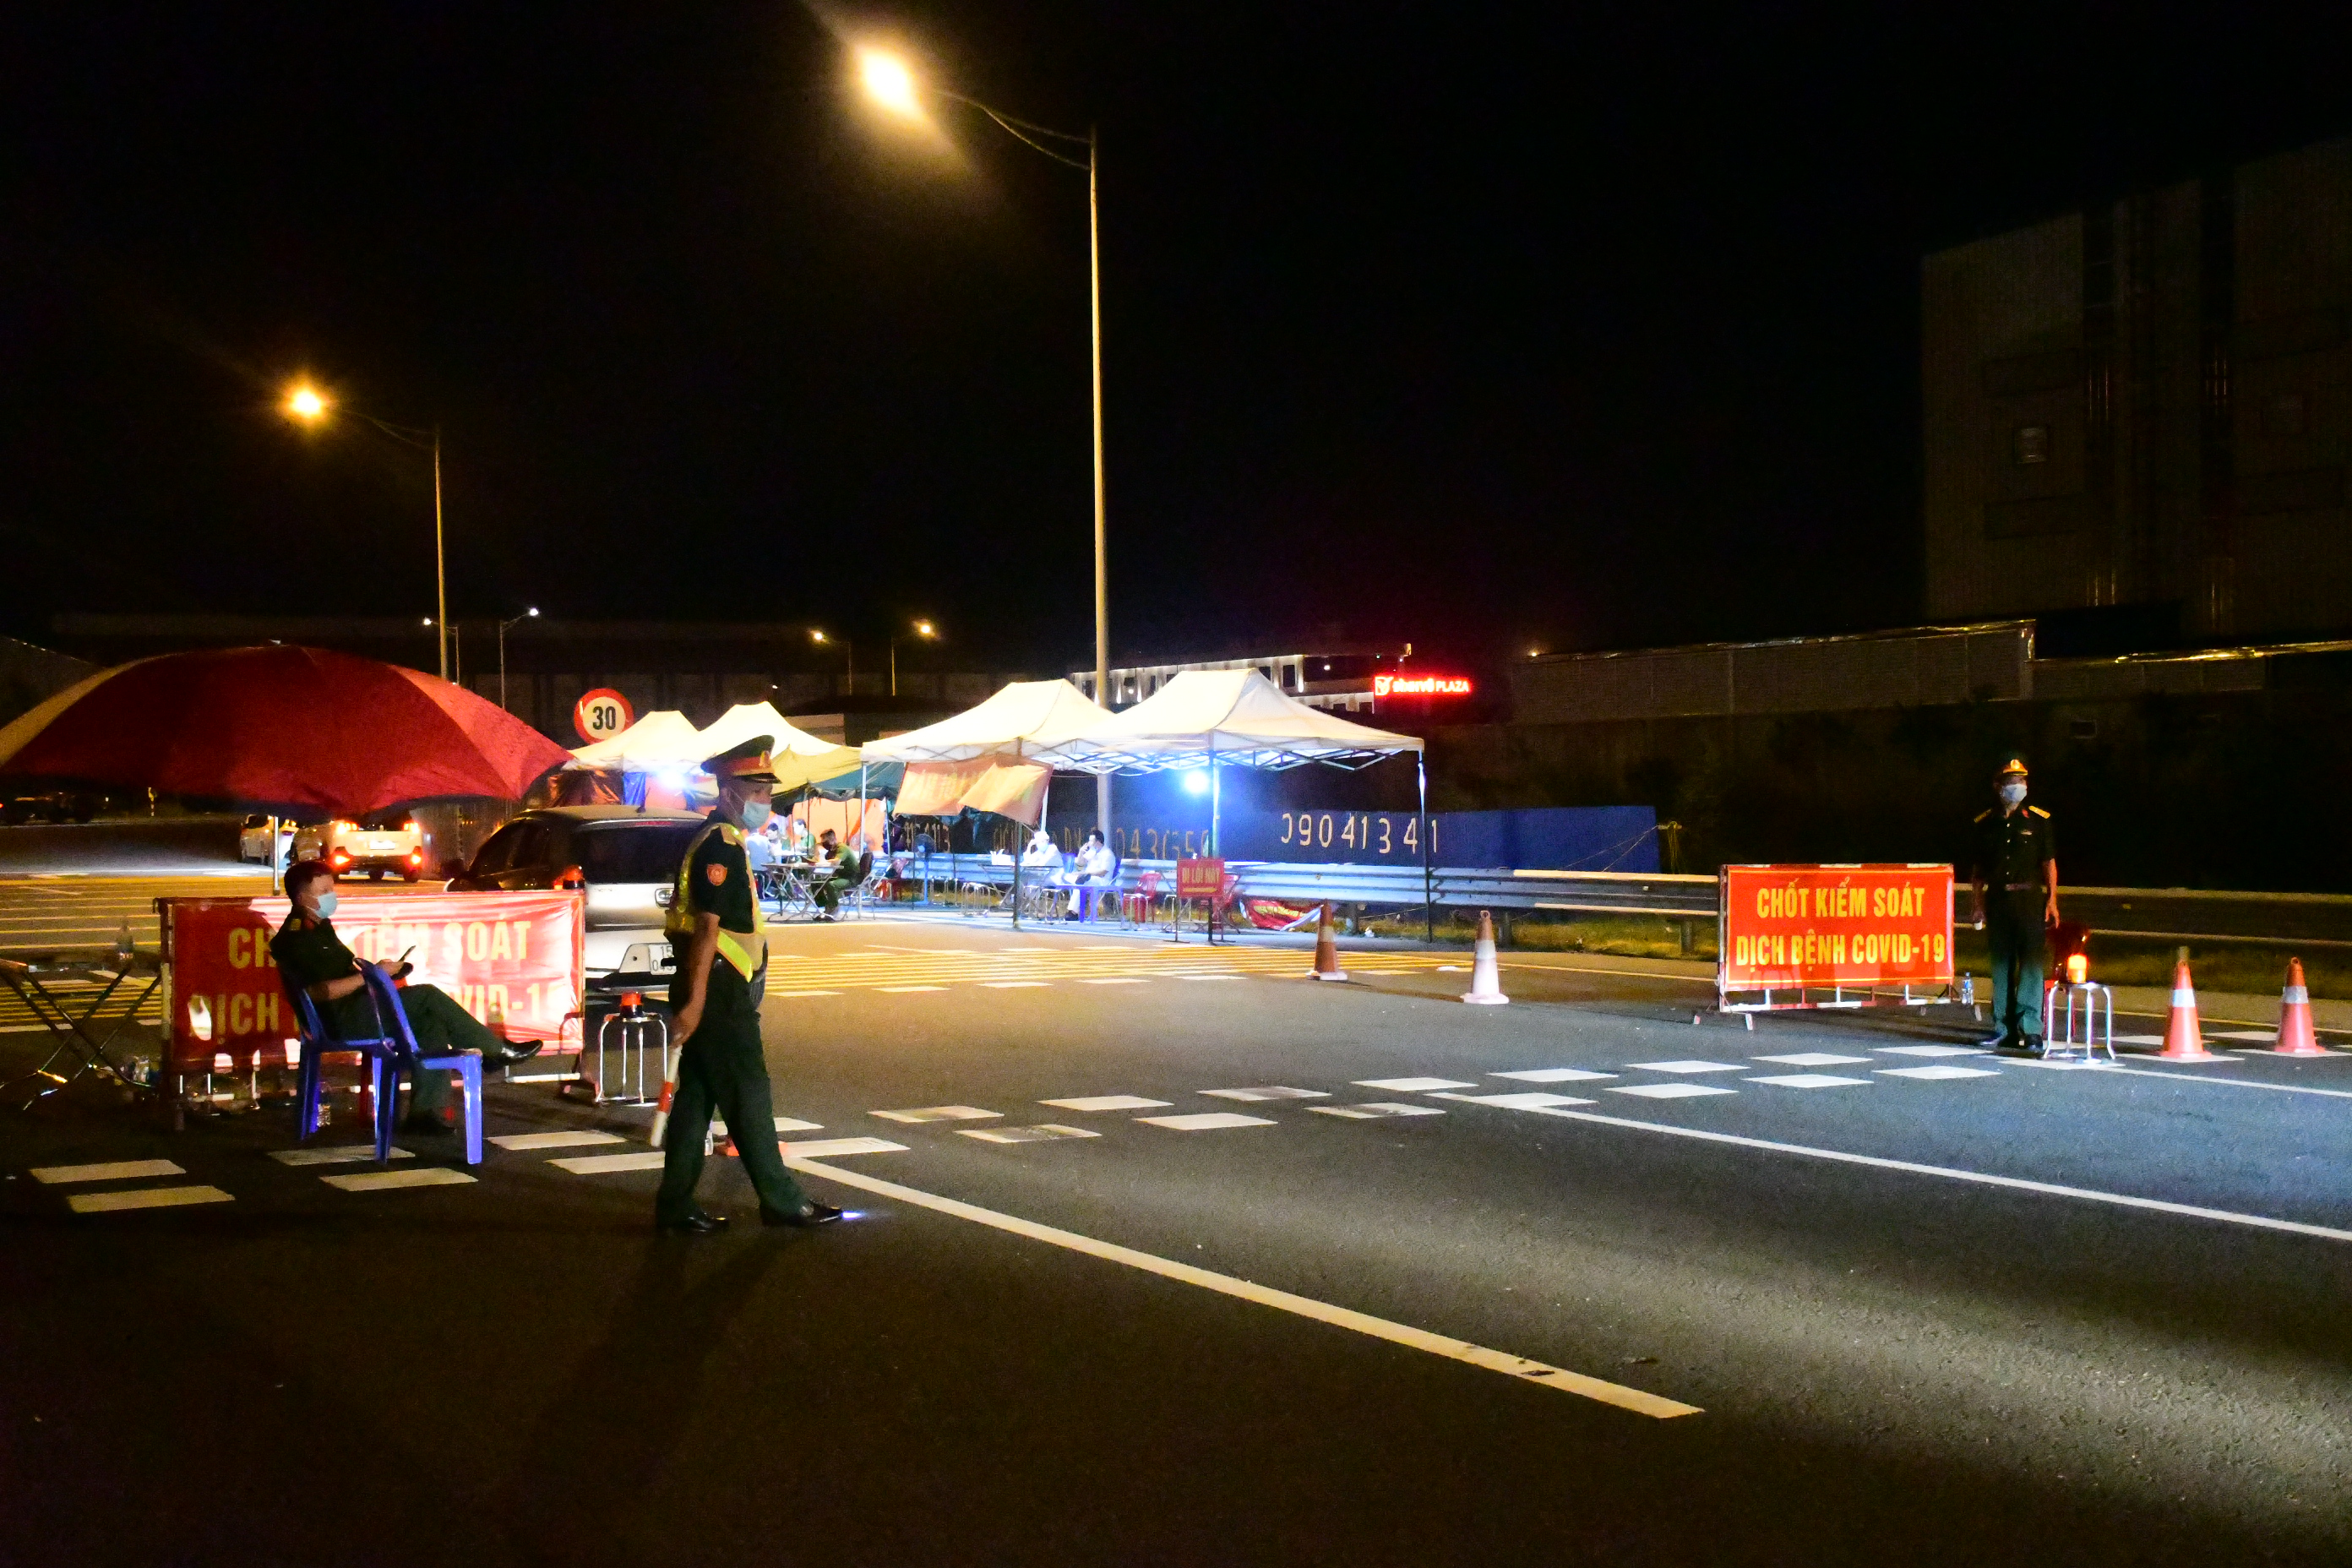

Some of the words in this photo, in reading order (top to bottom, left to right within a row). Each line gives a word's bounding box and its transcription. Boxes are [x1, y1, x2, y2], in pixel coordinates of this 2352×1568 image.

[1436, 680, 1469, 692] PLAZA
[592, 705, 617, 730] 30
[1756, 878, 1810, 918] CHỐT
[1816, 876, 1866, 917] KIỂM
[1874, 881, 1925, 917] SOÁT
[228, 927, 277, 969] CH
[443, 913, 532, 961] SOÁT
[1736, 934, 1784, 972] DỊCH
[1791, 928, 1846, 972] BỆNH
[1852, 934, 1946, 964] COVID-19
